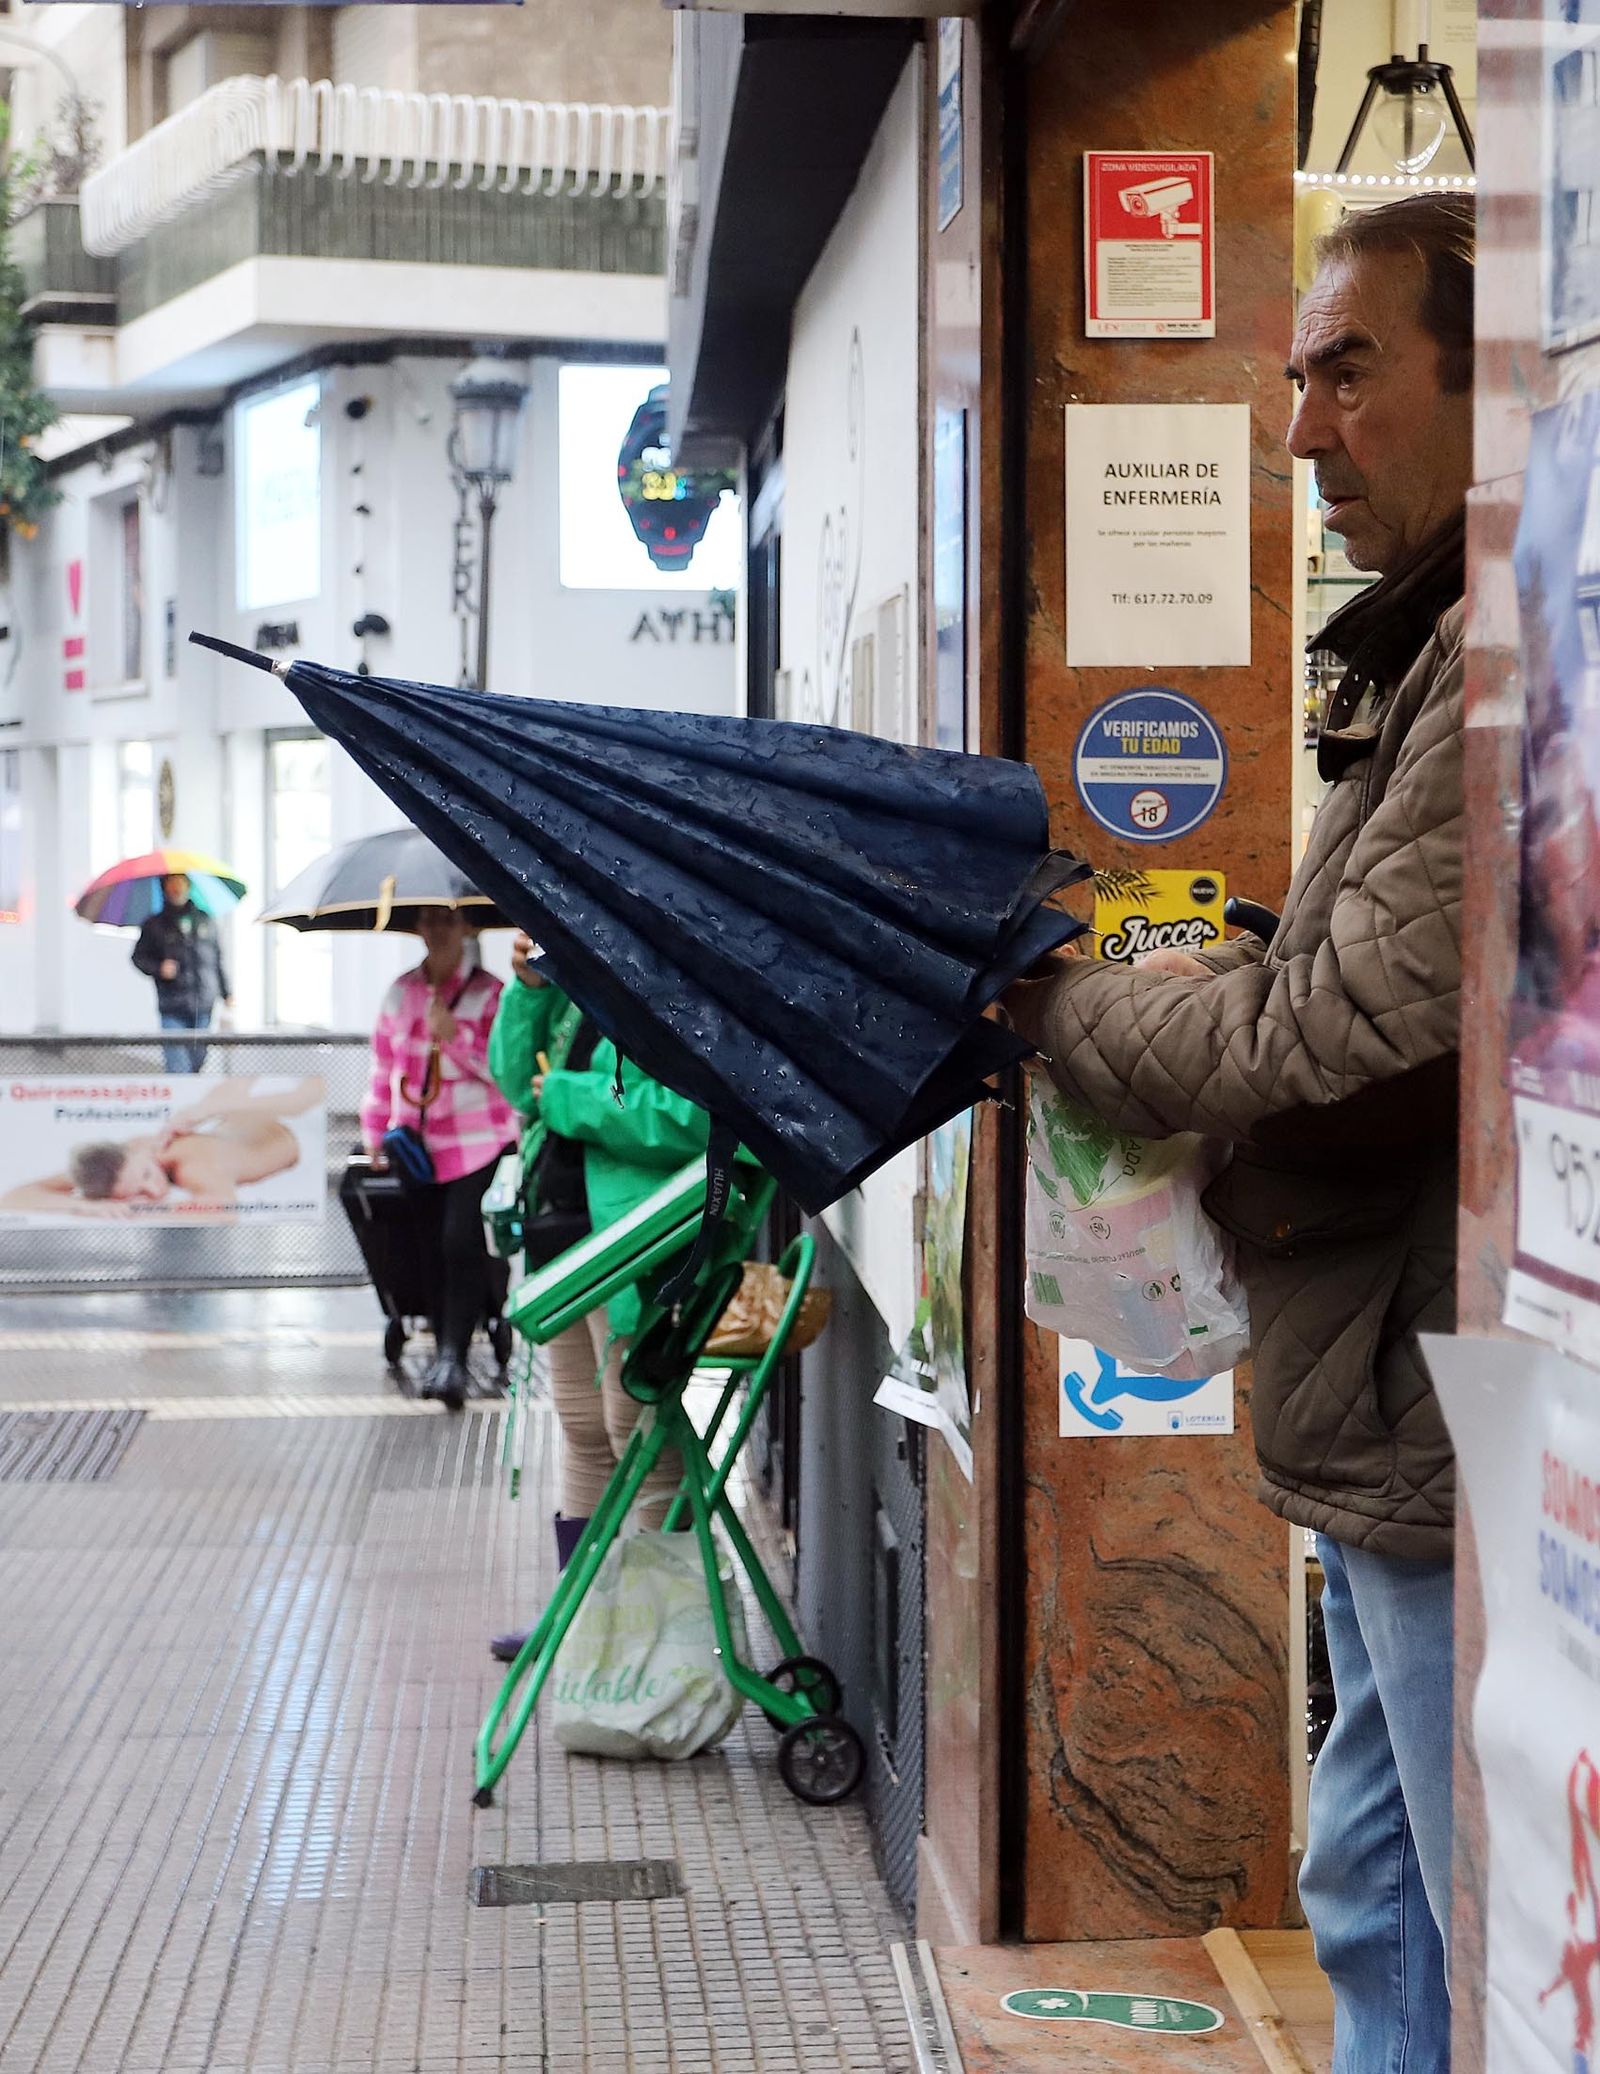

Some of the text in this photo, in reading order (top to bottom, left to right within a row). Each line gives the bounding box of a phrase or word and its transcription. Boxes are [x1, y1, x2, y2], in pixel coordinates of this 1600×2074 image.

[1101, 163, 1126, 172] ZONA
[1104, 463, 1219, 478] AUXILIAR DE
[1103, 486, 1222, 505] ENFERMERÍA
[1134, 593, 1213, 605] 617.72.70.09
[1103, 720, 1199, 738] VERIFICAMOS
[1121, 737, 1181, 754] TU EDAD
[1142, 807, 1157, 822] 18
[709, 1168, 724, 1216] HUAXIN
